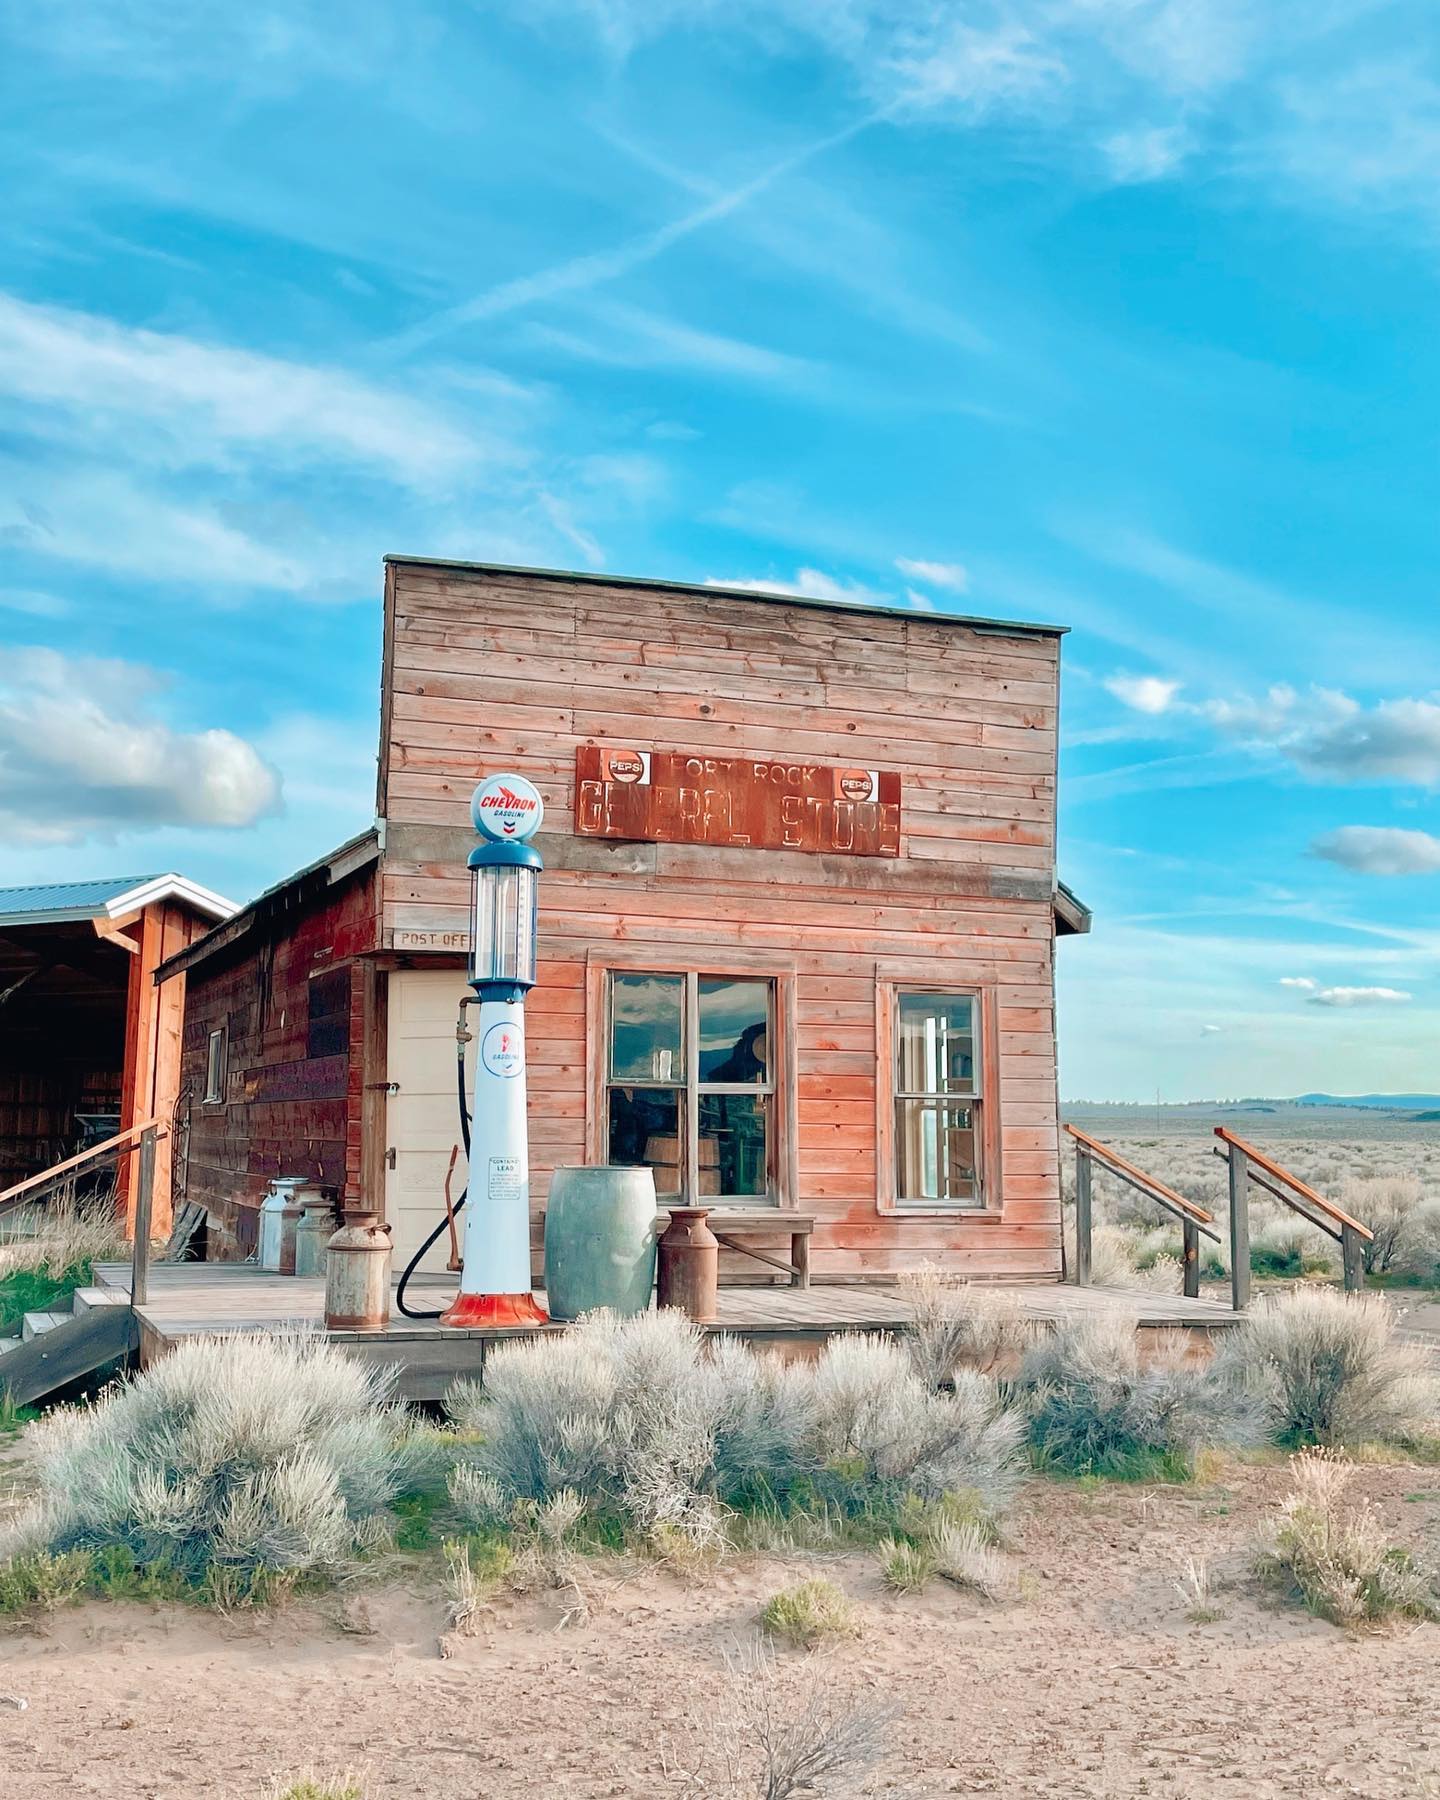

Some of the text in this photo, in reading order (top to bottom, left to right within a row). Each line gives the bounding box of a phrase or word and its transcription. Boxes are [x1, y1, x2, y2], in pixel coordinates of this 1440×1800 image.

[609, 760, 643, 772] PEPSI
[753, 763, 817, 785] ROCK
[841, 779, 872, 791] PEPSI
[480, 794, 537, 811] CHEVRON
[493, 809, 526, 818] GASOLINE
[401, 933, 437, 945] POST
